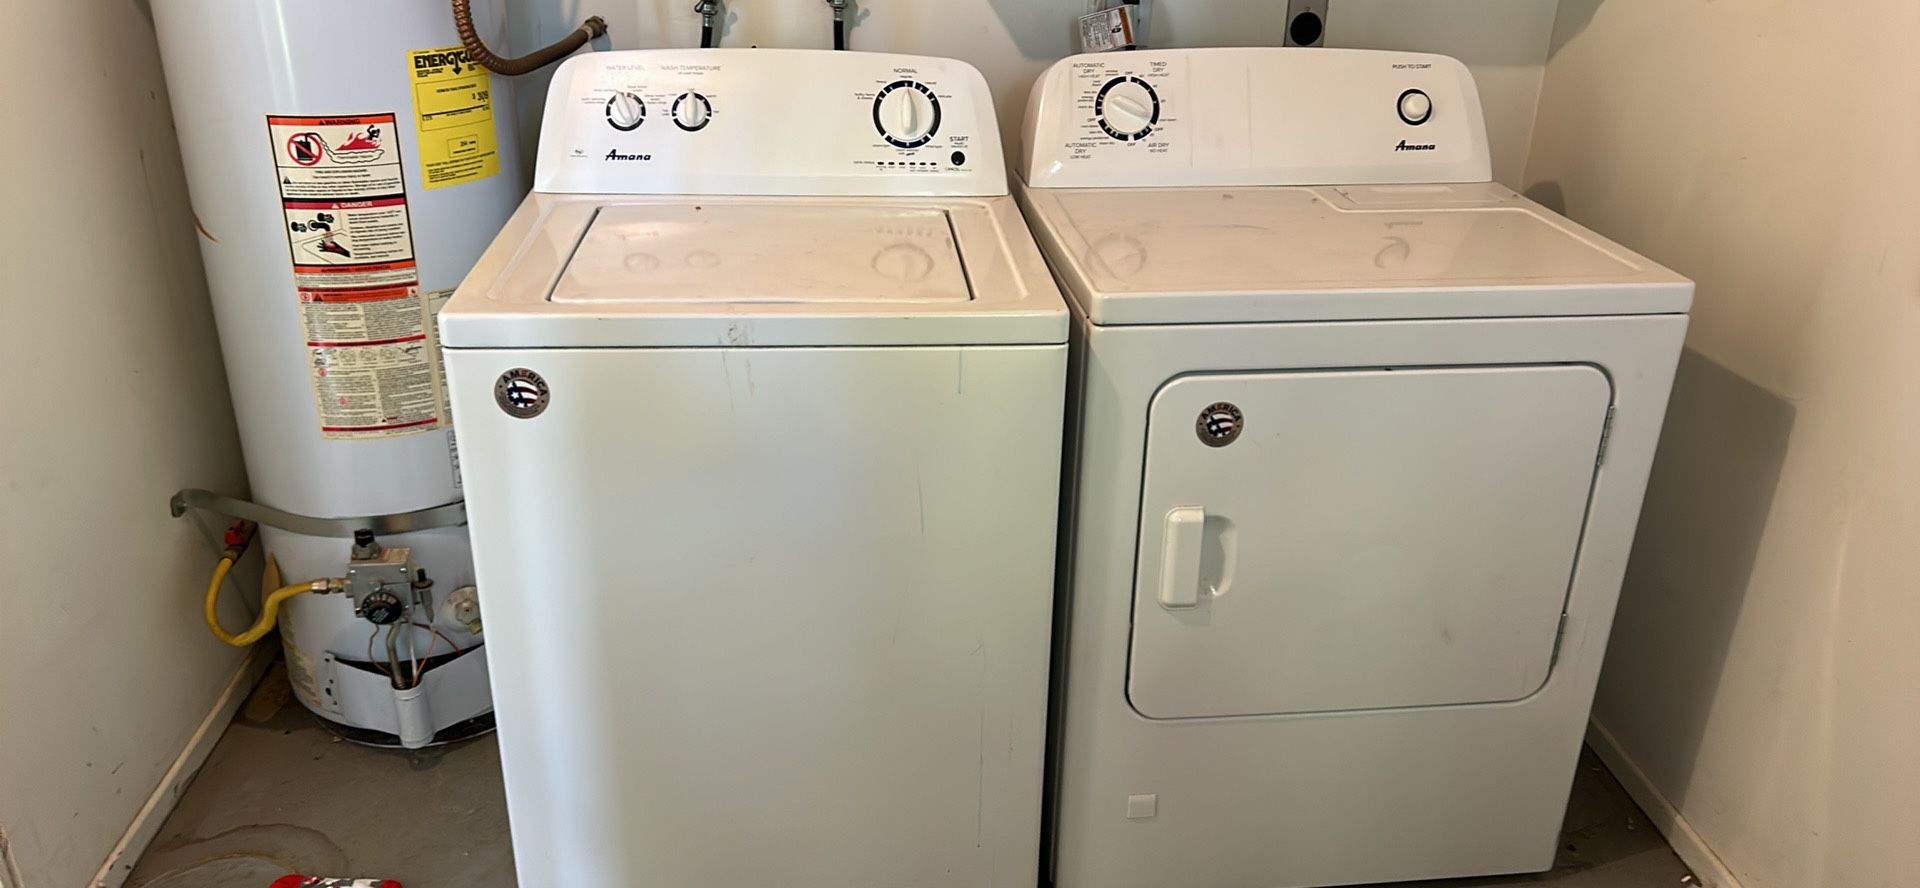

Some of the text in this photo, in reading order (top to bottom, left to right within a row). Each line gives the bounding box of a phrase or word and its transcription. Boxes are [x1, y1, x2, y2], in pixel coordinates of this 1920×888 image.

[1395, 140, 1436, 151] Amana
[605, 149, 652, 161] Amana
[503, 370, 548, 396] AMERICA
